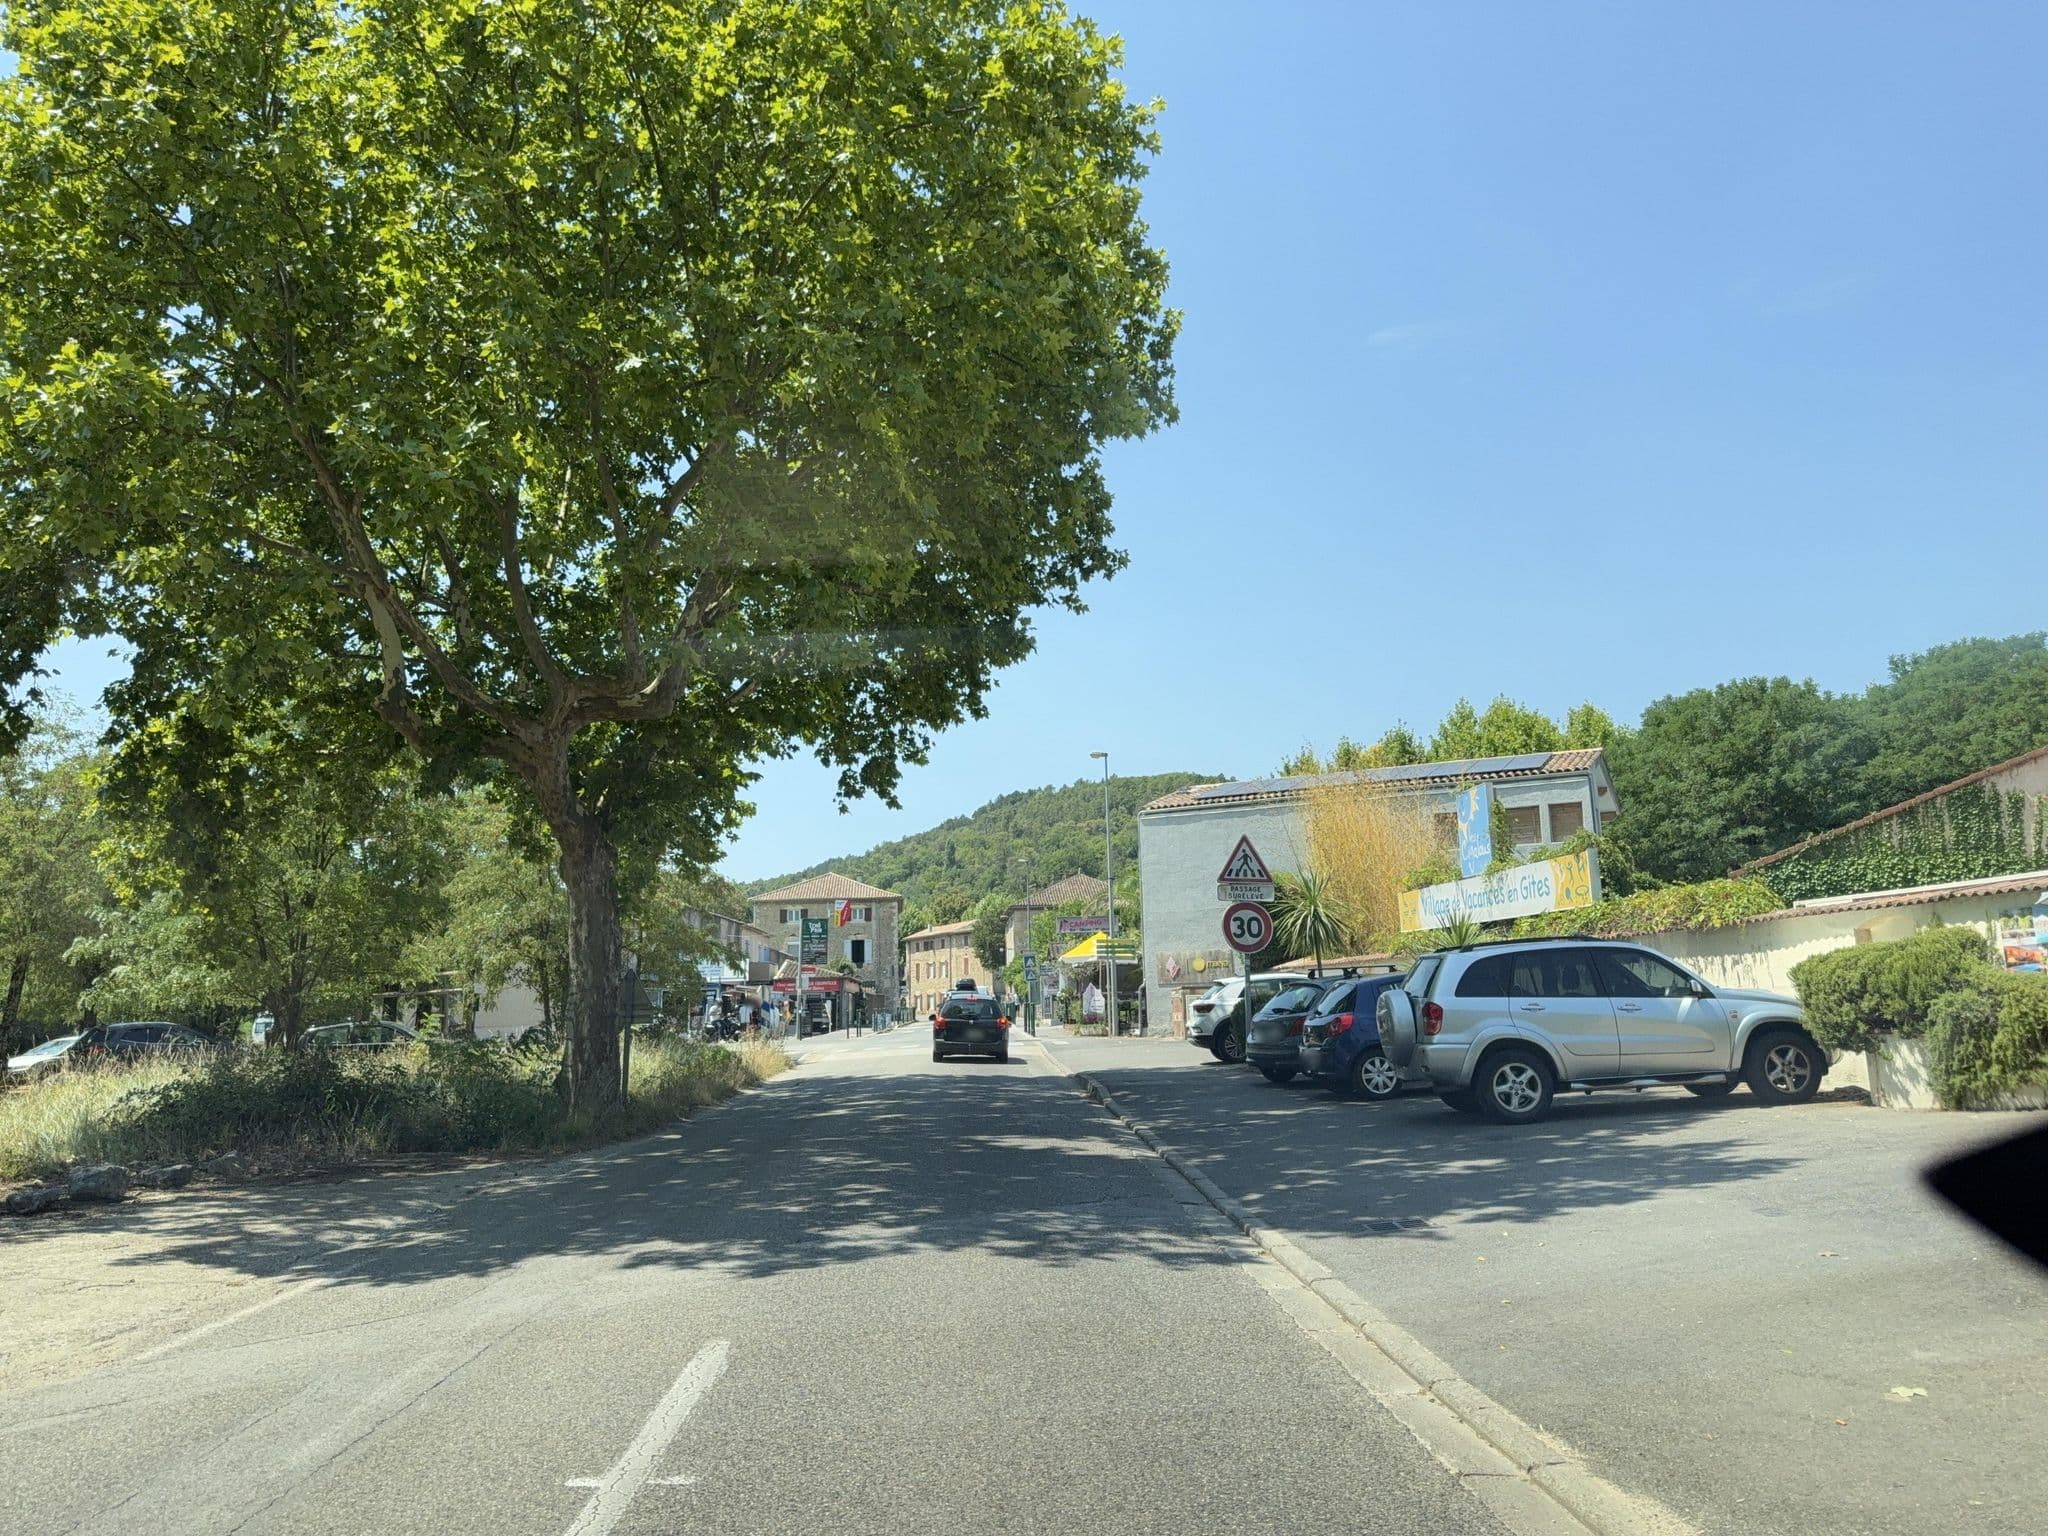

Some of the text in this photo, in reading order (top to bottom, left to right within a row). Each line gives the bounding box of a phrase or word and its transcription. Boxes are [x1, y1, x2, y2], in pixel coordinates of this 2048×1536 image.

[1421, 894, 1450, 916] Village
[1452, 895, 1461, 912] de
[1461, 886, 1505, 912] Vacances
[1508, 887, 1518, 902] en
[1232, 916, 1263, 939] 30
